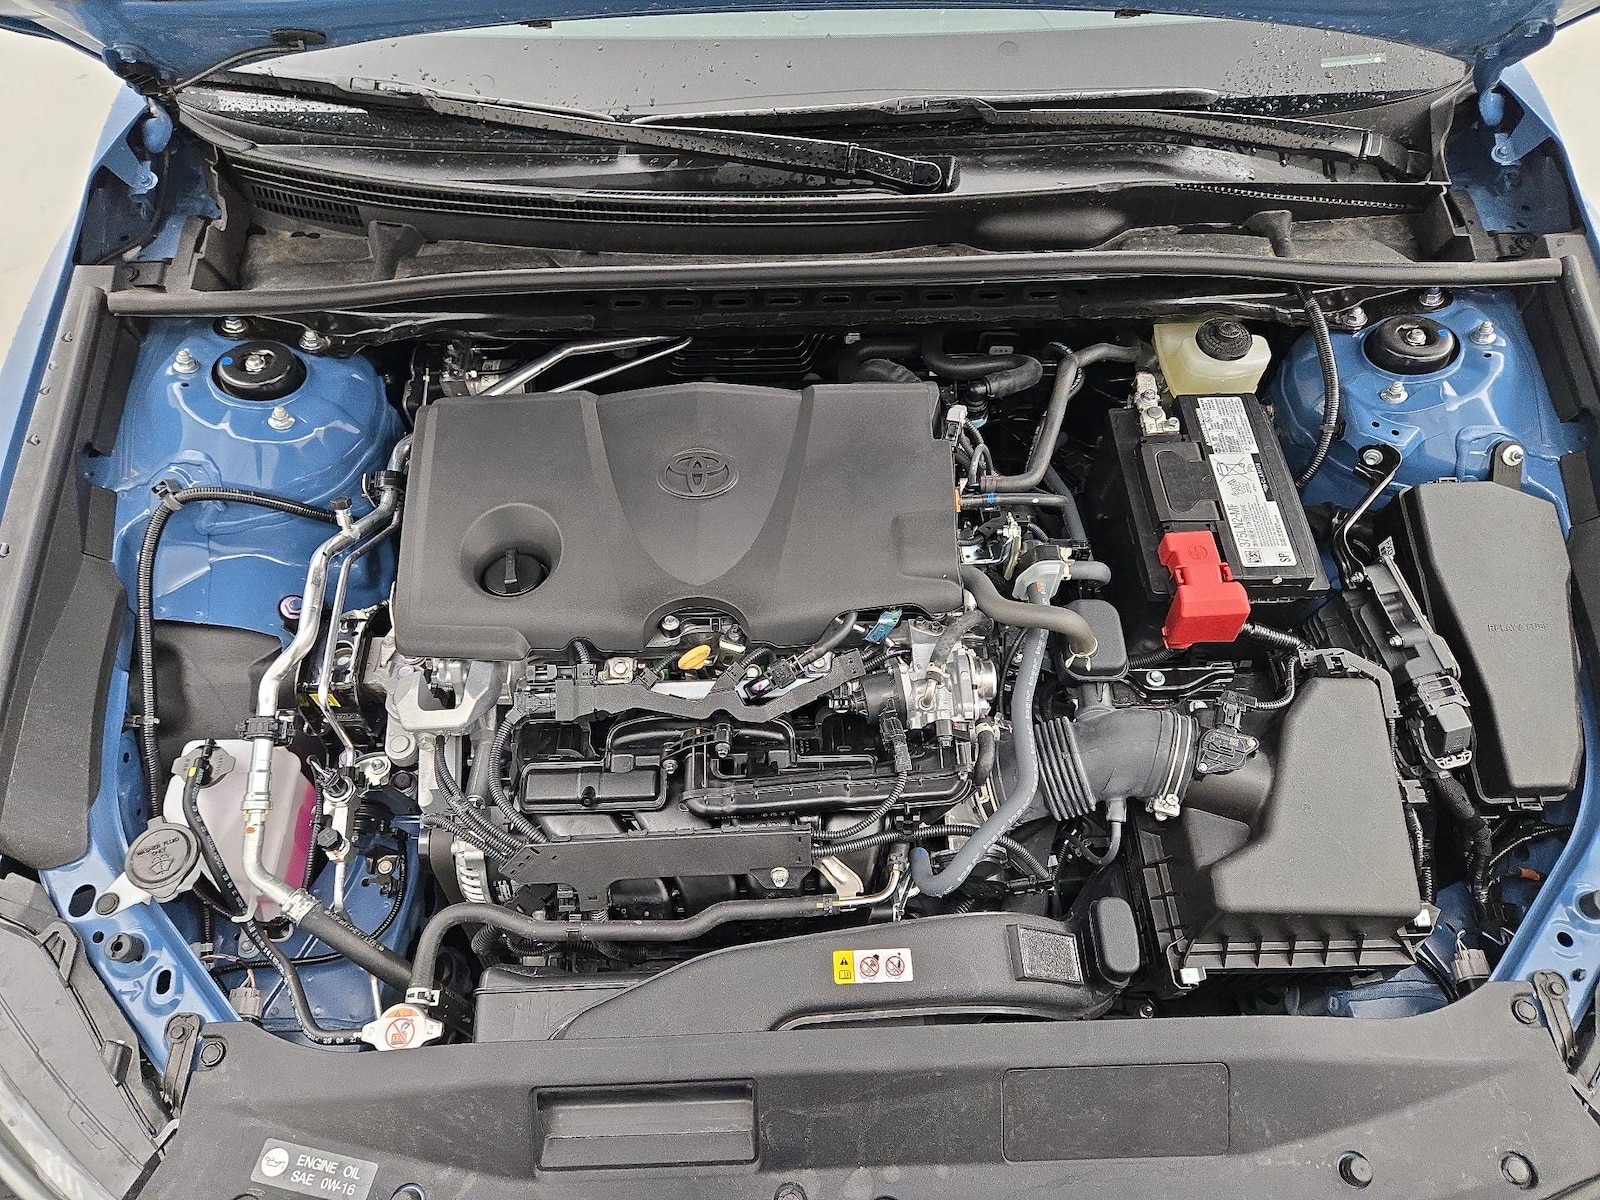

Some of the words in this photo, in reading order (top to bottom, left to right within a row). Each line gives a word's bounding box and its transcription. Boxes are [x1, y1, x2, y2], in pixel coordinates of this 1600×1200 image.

[1227, 503, 1251, 548] 375LN2-MF
[1278, 553, 1292, 563] SP
[296, 1154, 339, 1174] ENGINE
[343, 1165, 361, 1180] OIL
[290, 1170, 316, 1186] SAE
[320, 1177, 357, 1196] 0W-16
